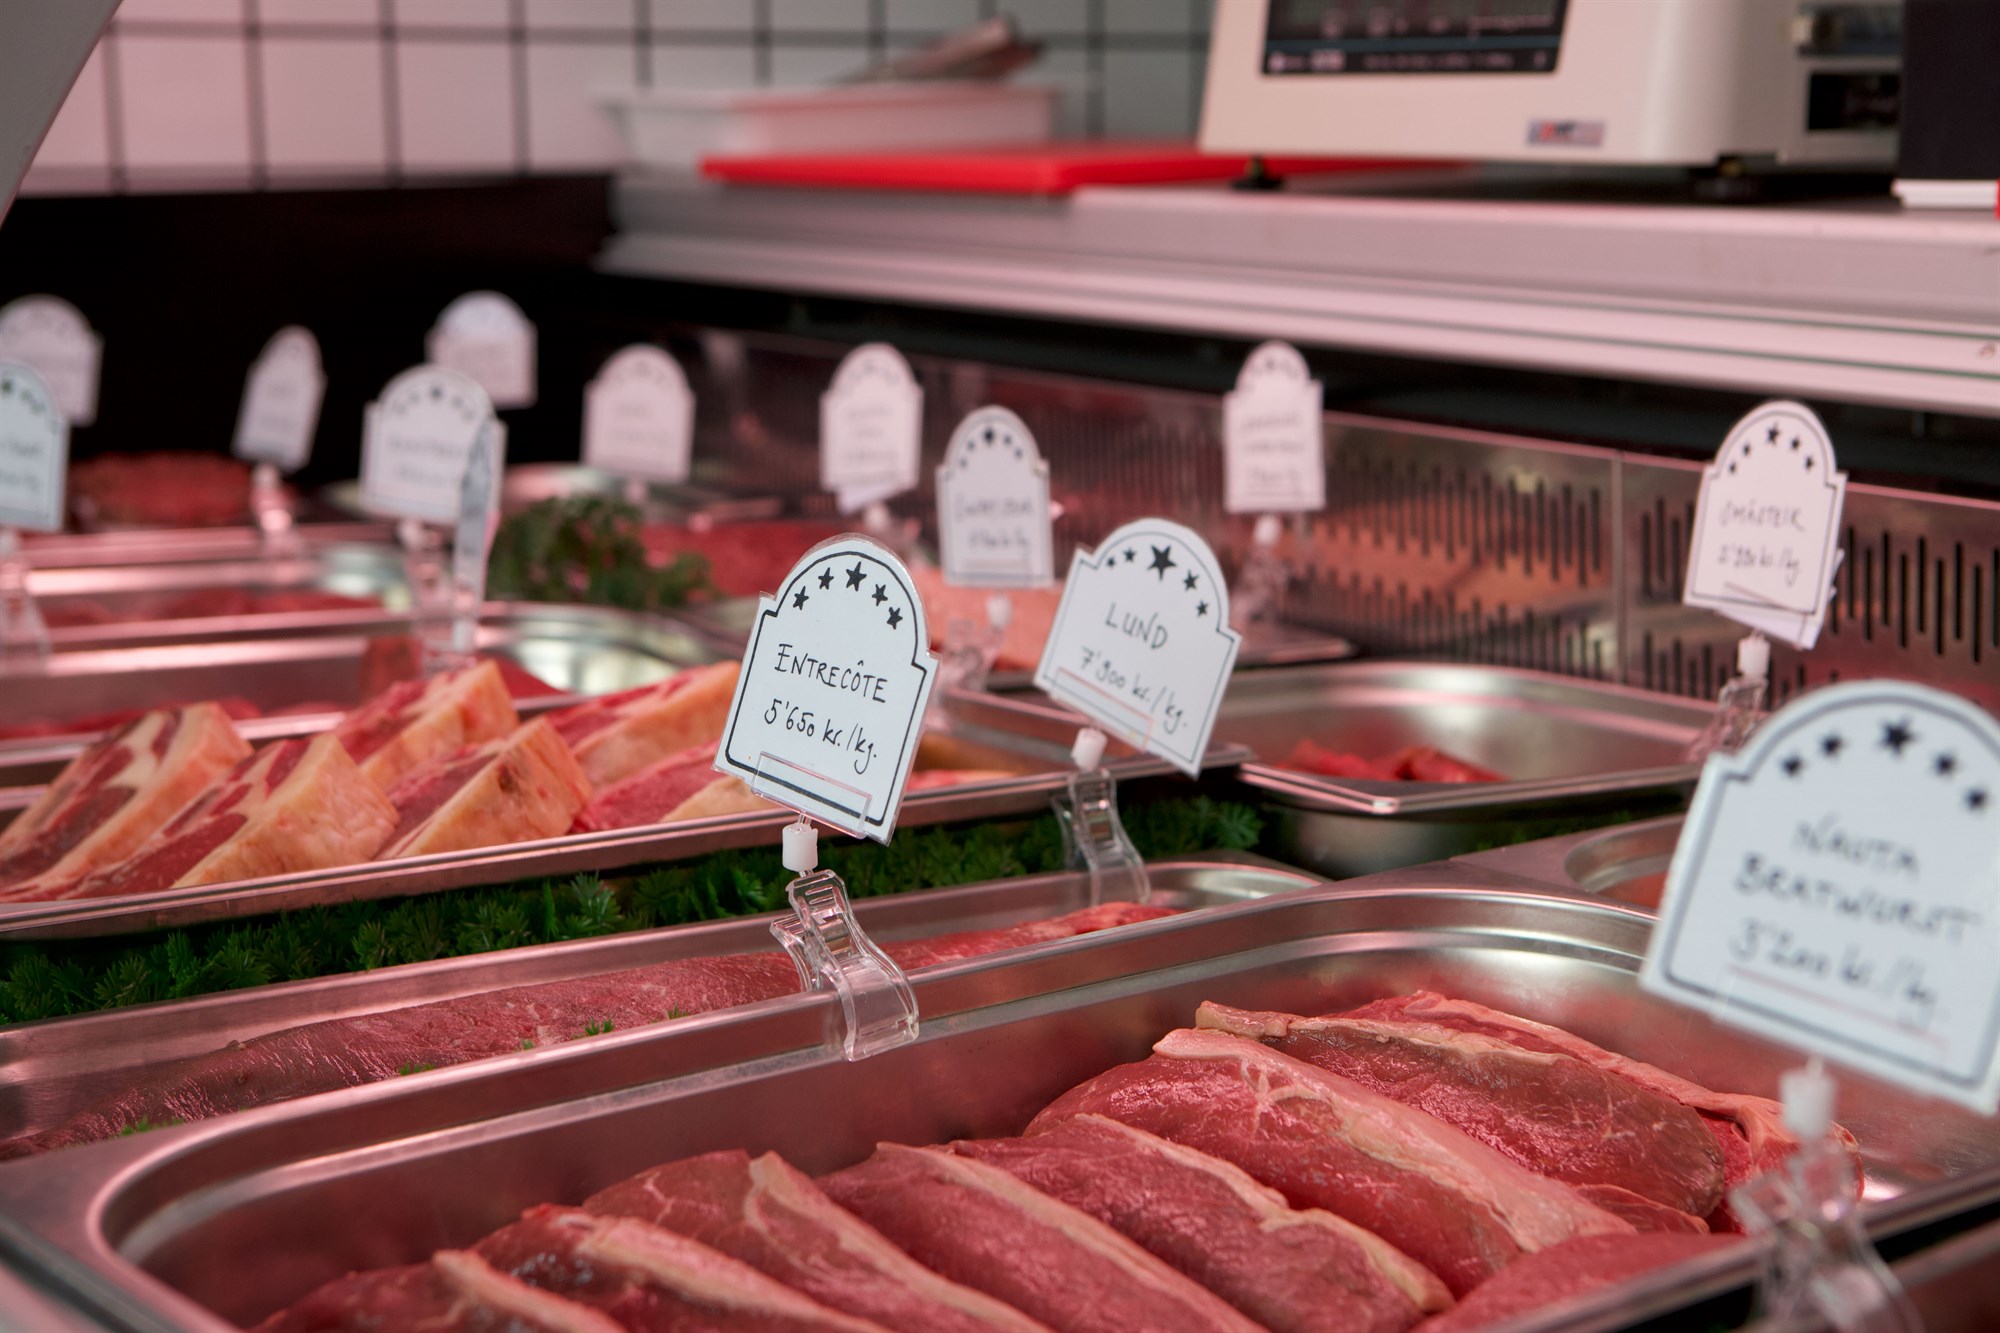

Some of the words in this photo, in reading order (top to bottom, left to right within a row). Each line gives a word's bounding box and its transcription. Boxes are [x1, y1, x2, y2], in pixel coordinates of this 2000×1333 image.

[1105, 602, 1168, 649] LUND
[774, 643, 888, 703] ENTRECÔTE
[764, 698, 815, 737] 5'650
[1791, 811, 1920, 881] NAUTA
